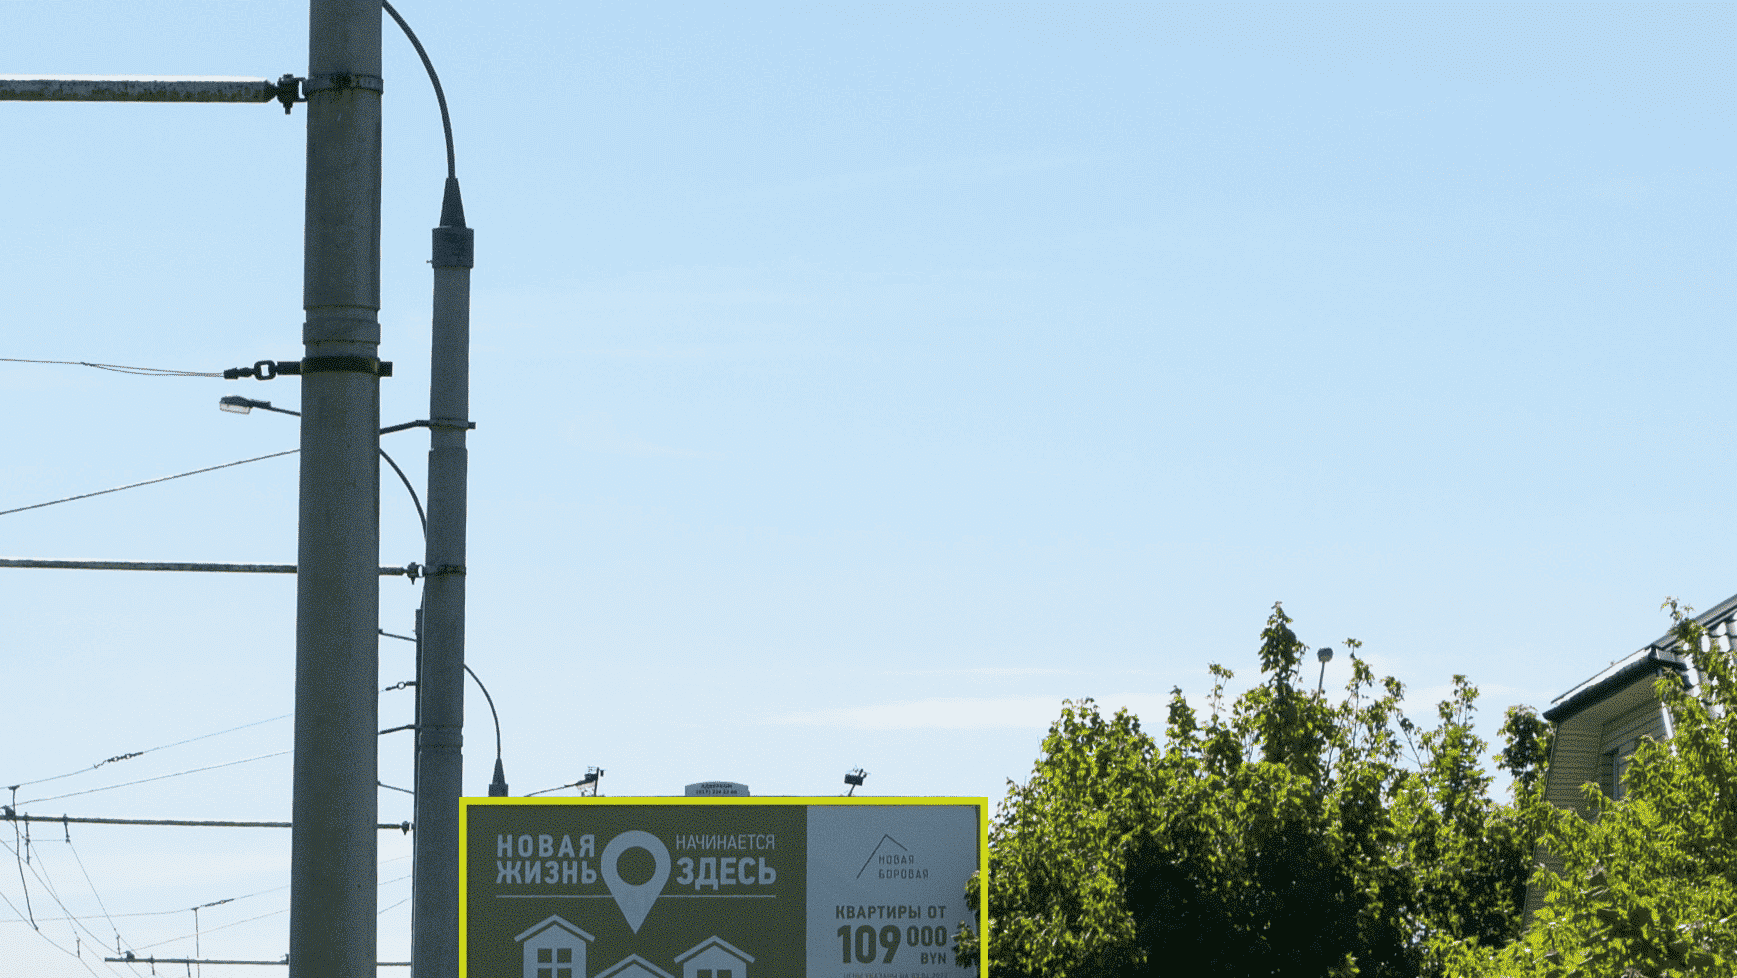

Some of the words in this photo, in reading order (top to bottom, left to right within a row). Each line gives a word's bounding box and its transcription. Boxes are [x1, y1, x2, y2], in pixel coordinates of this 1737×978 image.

[497, 834, 595, 858] НОВАЯ
[676, 834, 775, 851] НАЧИНАЕТСЯ
[879, 855, 914, 865] НОВАЯ
[496, 860, 597, 884] ЖИЗНЬ
[676, 857, 777, 890] ЗДЕСЬ
[878, 869, 929, 879] БОРОВАЯ
[835, 905, 921, 919] КВАРТИРЫ
[927, 905, 946, 919] ОТ
[837, 925, 902, 964] 109
[906, 926, 948, 947] 000
[920, 953, 947, 965] BYN
